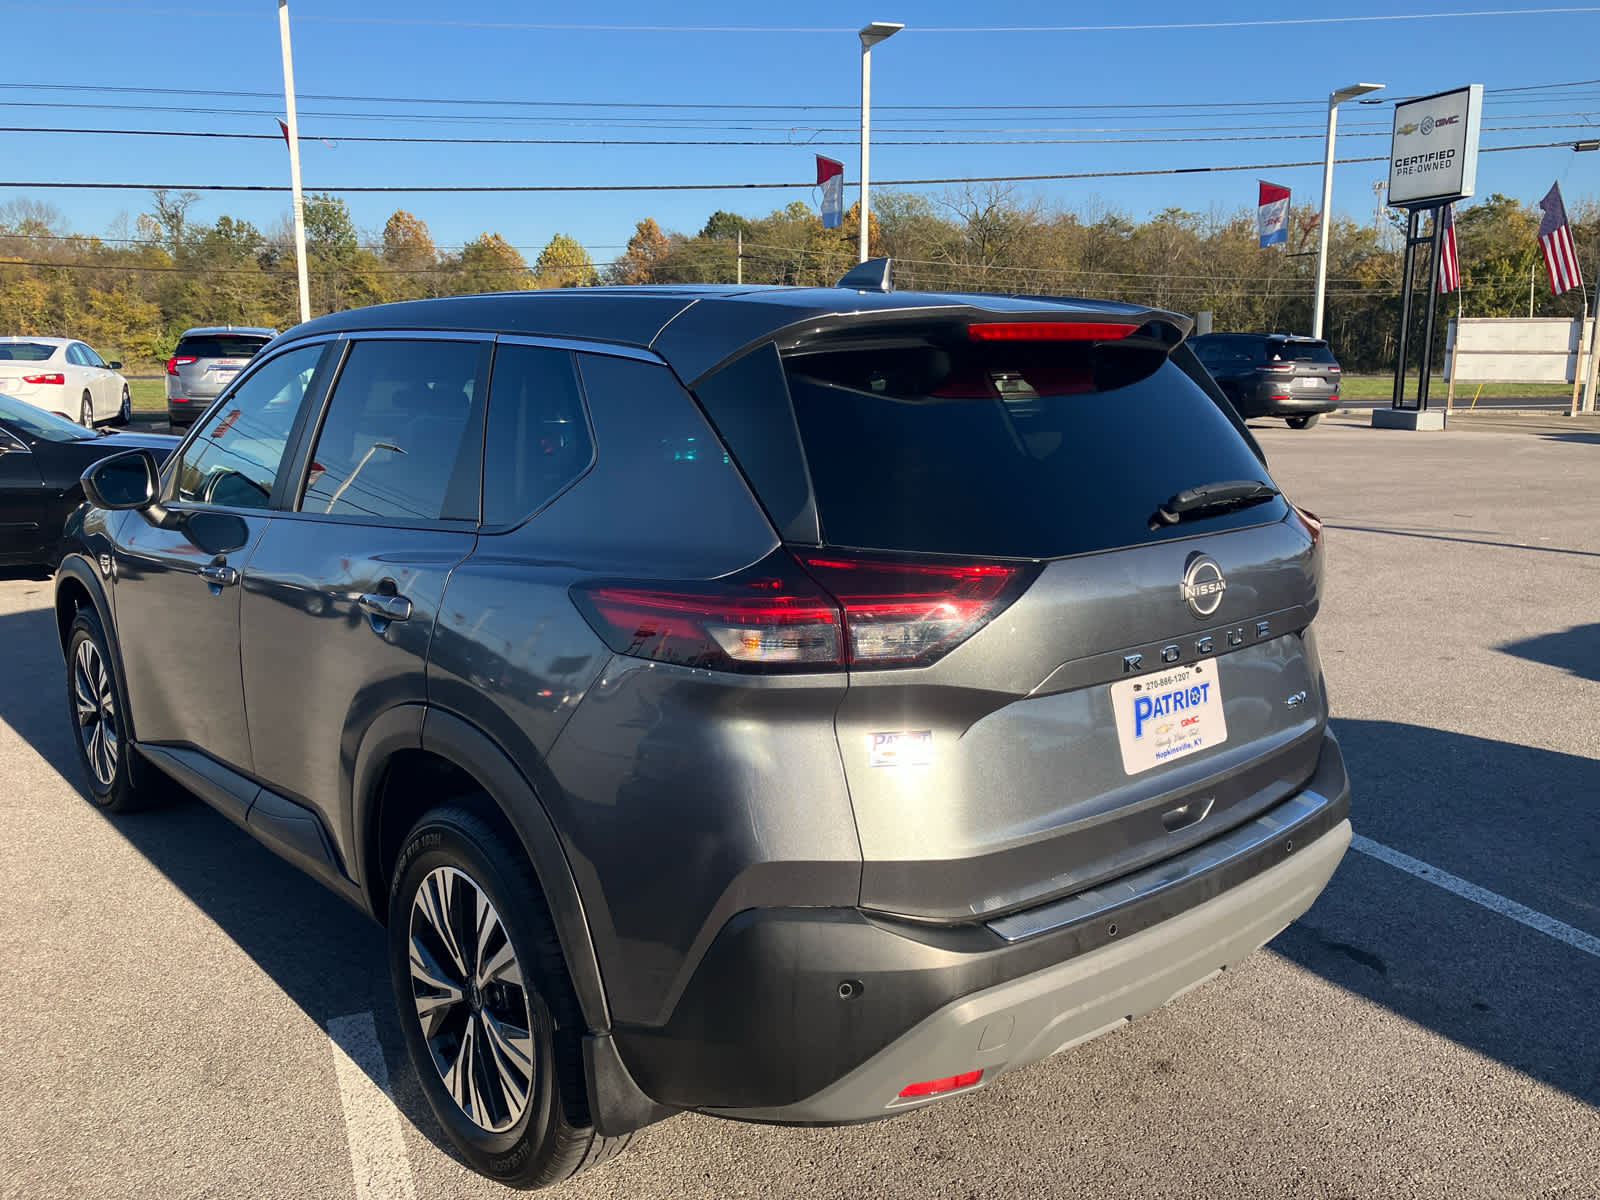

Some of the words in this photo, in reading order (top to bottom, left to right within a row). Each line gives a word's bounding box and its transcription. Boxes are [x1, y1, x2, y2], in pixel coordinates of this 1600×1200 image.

[1434, 115, 1460, 128] GMC
[1395, 149, 1456, 168] CERTIFIED
[1396, 159, 1452, 176] PRE-OWNED
[1185, 580, 1227, 599] NISSAN
[1123, 621, 1271, 673] ROGUE
[1133, 682, 1210, 739] PATRIOT
[1180, 715, 1200, 727] GMC
[872, 733, 930, 752] PATT
